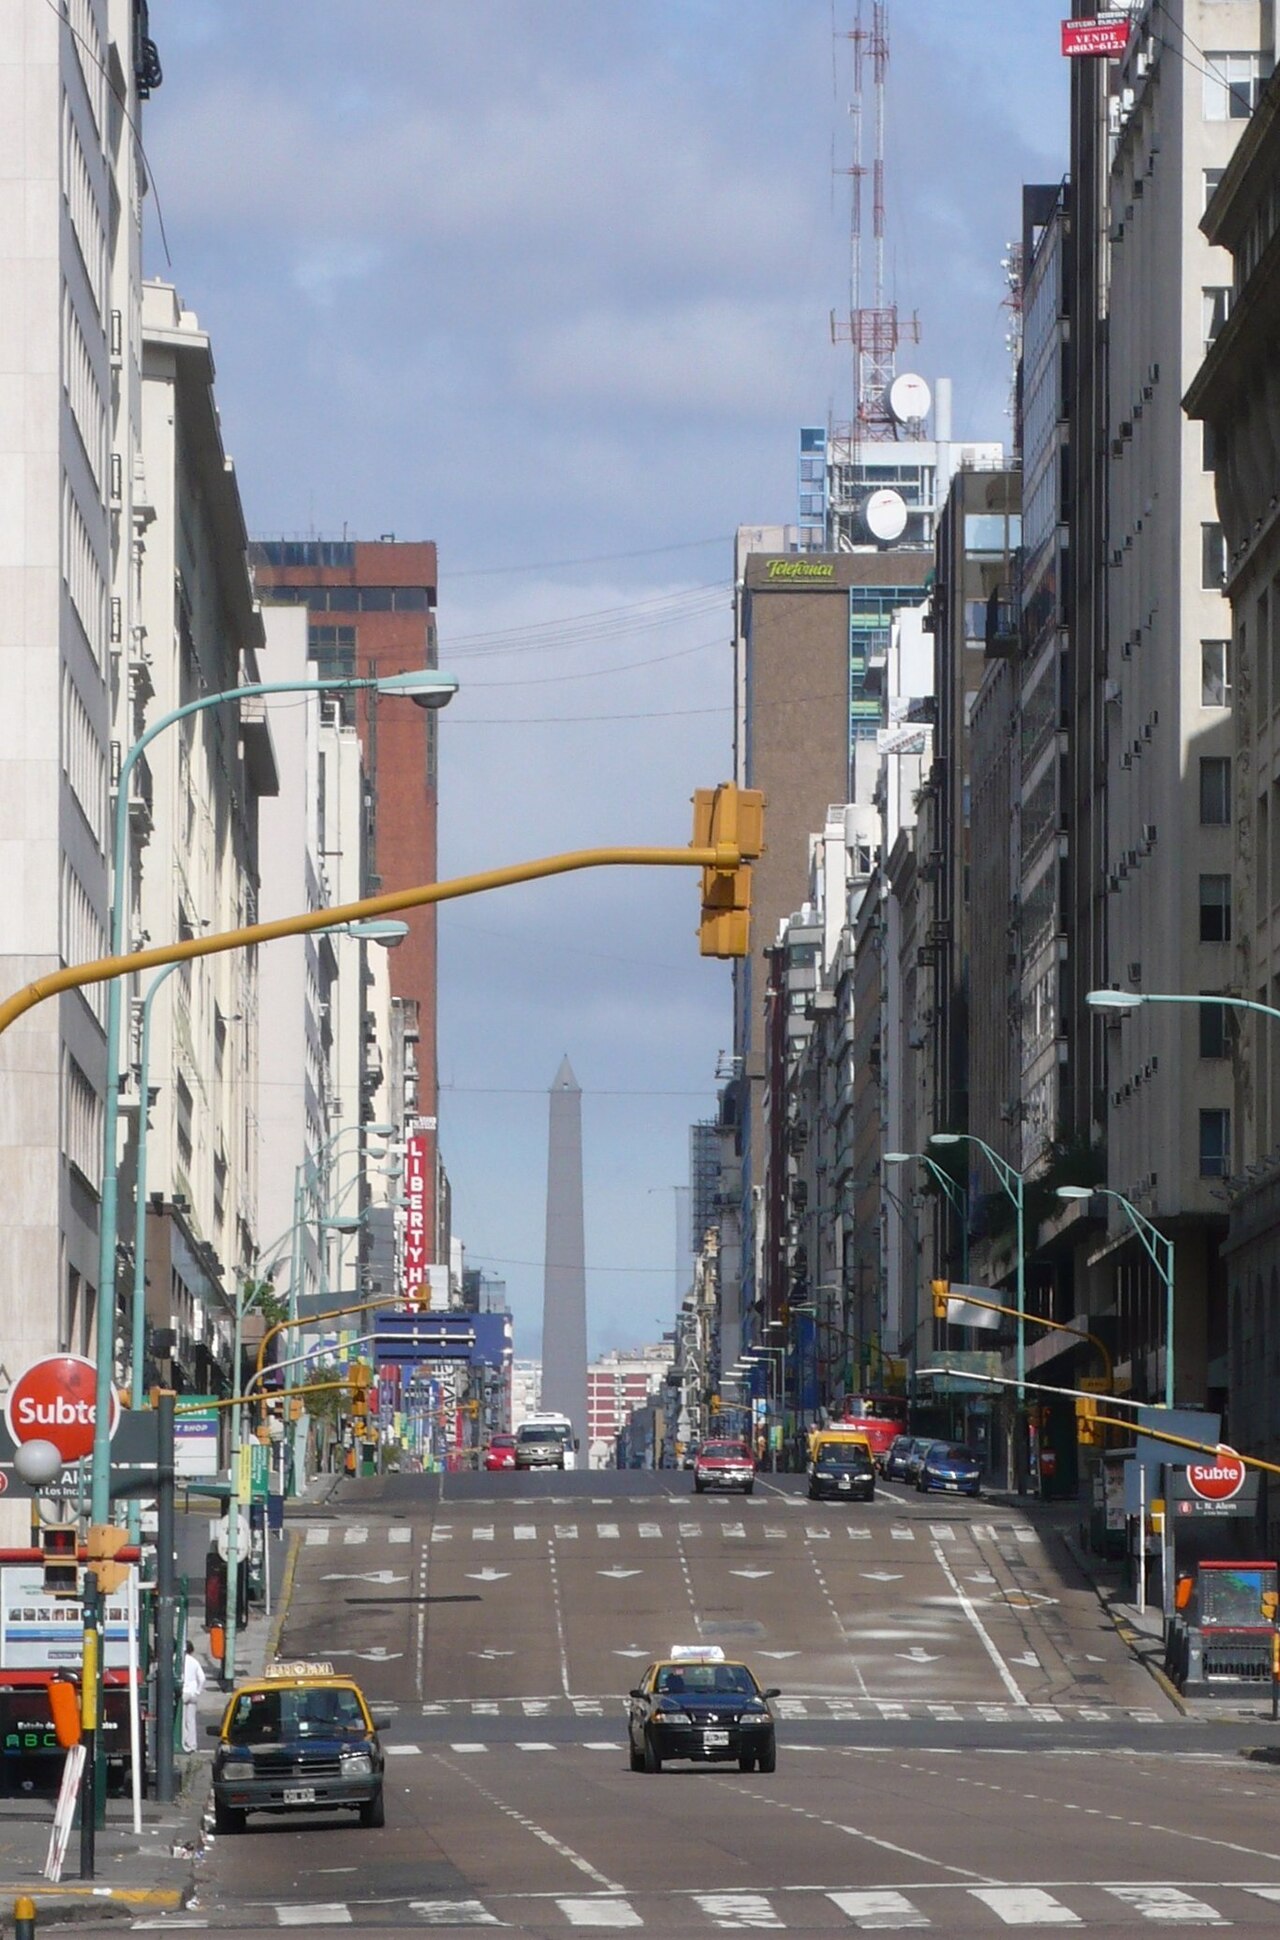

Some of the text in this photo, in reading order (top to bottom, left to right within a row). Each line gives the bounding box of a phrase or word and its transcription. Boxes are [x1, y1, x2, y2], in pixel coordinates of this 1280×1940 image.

[1075, 32, 1118, 43] VENDE
[1065, 40, 1127, 53] 4803-6123
[409, 1140, 424, 1259] LIBERTY
[183, 1424, 208, 1432] SHOP
[1194, 1466, 1239, 1480] Subte
[45, 1487, 61, 1495] Los
[1216, 1502, 1236, 1510] Alem
[6, 1734, 19, 1748] A
[25, 1734, 37, 1746] B
